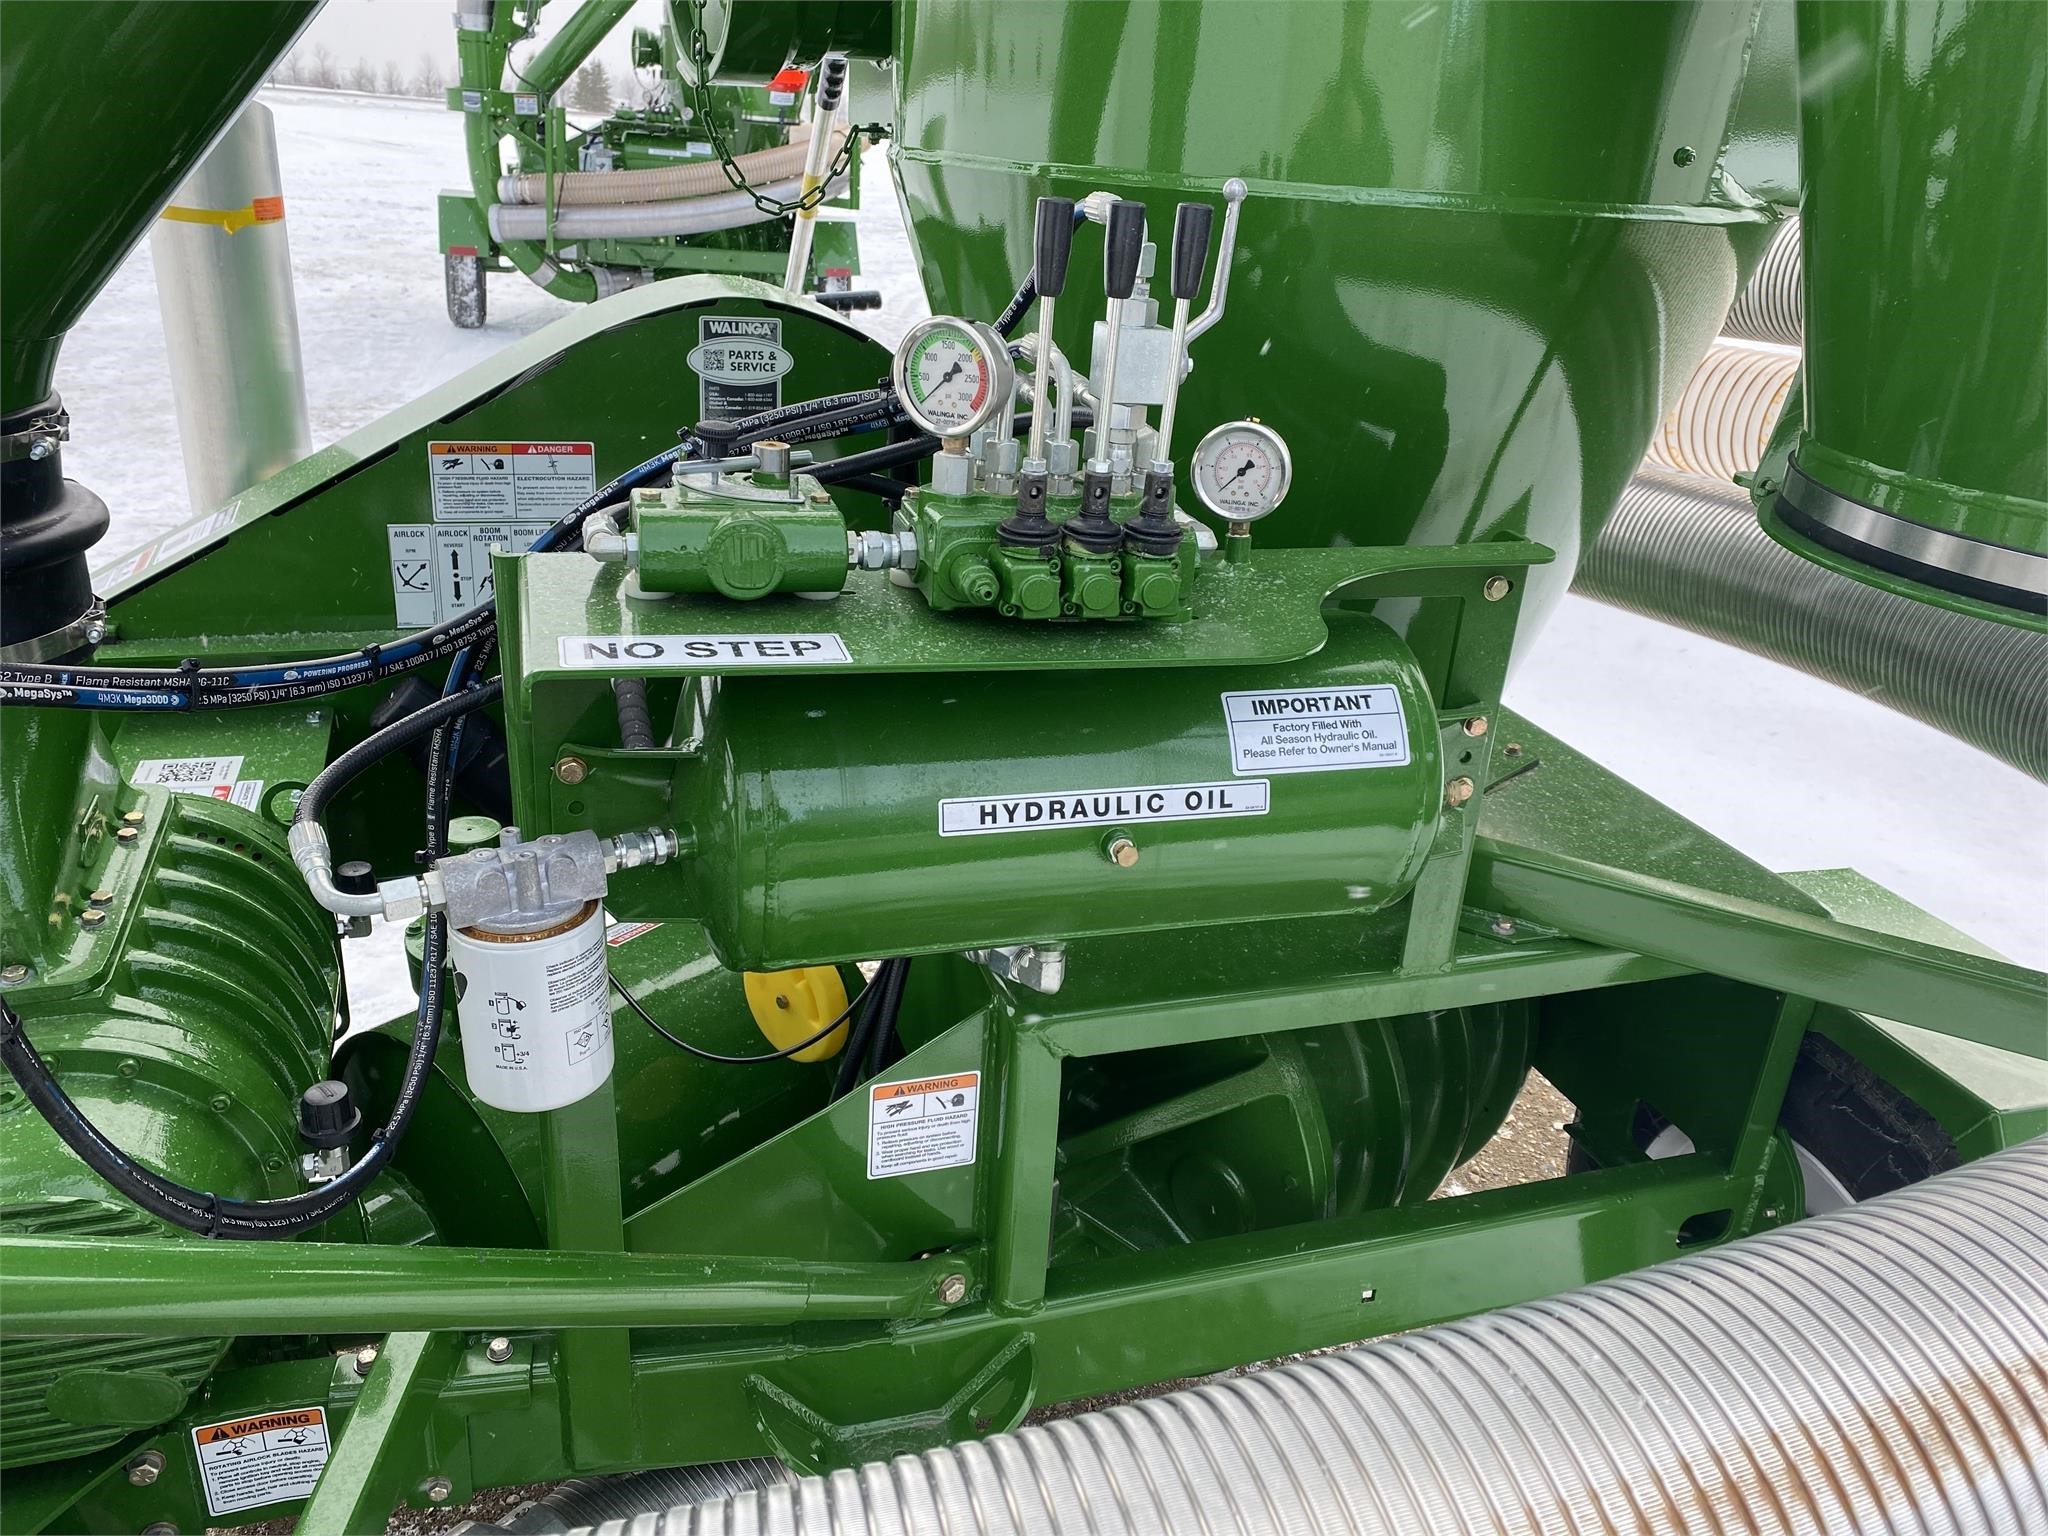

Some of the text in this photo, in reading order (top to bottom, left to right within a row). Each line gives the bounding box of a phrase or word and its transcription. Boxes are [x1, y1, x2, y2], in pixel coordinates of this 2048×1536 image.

[999, 309, 1014, 326] Type
[709, 321, 772, 336] WALINGA
[941, 340, 955, 350] 1500
[729, 350, 777, 361] PARTS &
[924, 352, 973, 363] 1000 2000
[730, 362, 776, 373] SERVICE
[918, 372, 979, 384] 500 2500
[958, 392, 973, 402] 3000
[741, 419, 759, 430] MPa
[861, 392, 875, 402] ISO
[927, 409, 955, 420] WALINGA
[779, 426, 811, 444] 100R17
[817, 422, 832, 432] ISO
[832, 417, 858, 429] 18752
[457, 445, 574, 454] WARNING DANGER
[638, 458, 660, 474] 4M3K
[394, 530, 425, 538] AIRLOCK
[437, 529, 469, 538] AIRLOCK
[479, 527, 501, 535] BOOM
[473, 534, 509, 542] ROTATION
[584, 641, 822, 660] NO STEP
[211, 693, 228, 705] MPa
[327, 679, 342, 692] ISO
[342, 674, 367, 688] 11237
[389, 662, 405, 675] SAE
[405, 653, 434, 671] 100R17
[439, 643, 454, 655] ISO
[453, 632, 478, 650] 18752
[477, 624, 496, 638] Type
[303, 666, 337, 679] POWERING
[45, 674, 53, 684] B
[75, 675, 110, 688] Flame
[112, 677, 160, 688] Resistant
[163, 677, 192, 687] MSHA
[97, 693, 122, 705] 4M3K
[123, 694, 169, 707] Mega3000
[1251, 694, 1373, 716] IMPORTANT
[1273, 719, 1362, 734] Factory Filled With
[1260, 729, 1378, 746] All Season Hydraulic Oil.
[1243, 740, 1398, 759] Please Refer to Owner's Manual
[429, 750, 440, 786] Resistant
[427, 787, 437, 811] Flame
[980, 789, 1233, 825] HYDRAULIC OIL
[427, 830, 436, 848] Type
[430, 925, 438, 940] SAE
[430, 946, 438, 962] R17
[429, 963, 438, 989] 11237
[428, 990, 437, 1005] ISO
[906, 1079, 959, 1094] WARNING
[396, 1099, 409, 1115] MPa
[387, 1115, 401, 1131] 22.5
[896, 1119, 926, 1128] PRESSURE
[928, 1116, 944, 1124] FLUID
[945, 1113, 968, 1121] HAZARD
[230, 1414, 310, 1435] WARNING
[209, 1446, 324, 1471] ROTATING AIRLOCK BLADES HAZARD
